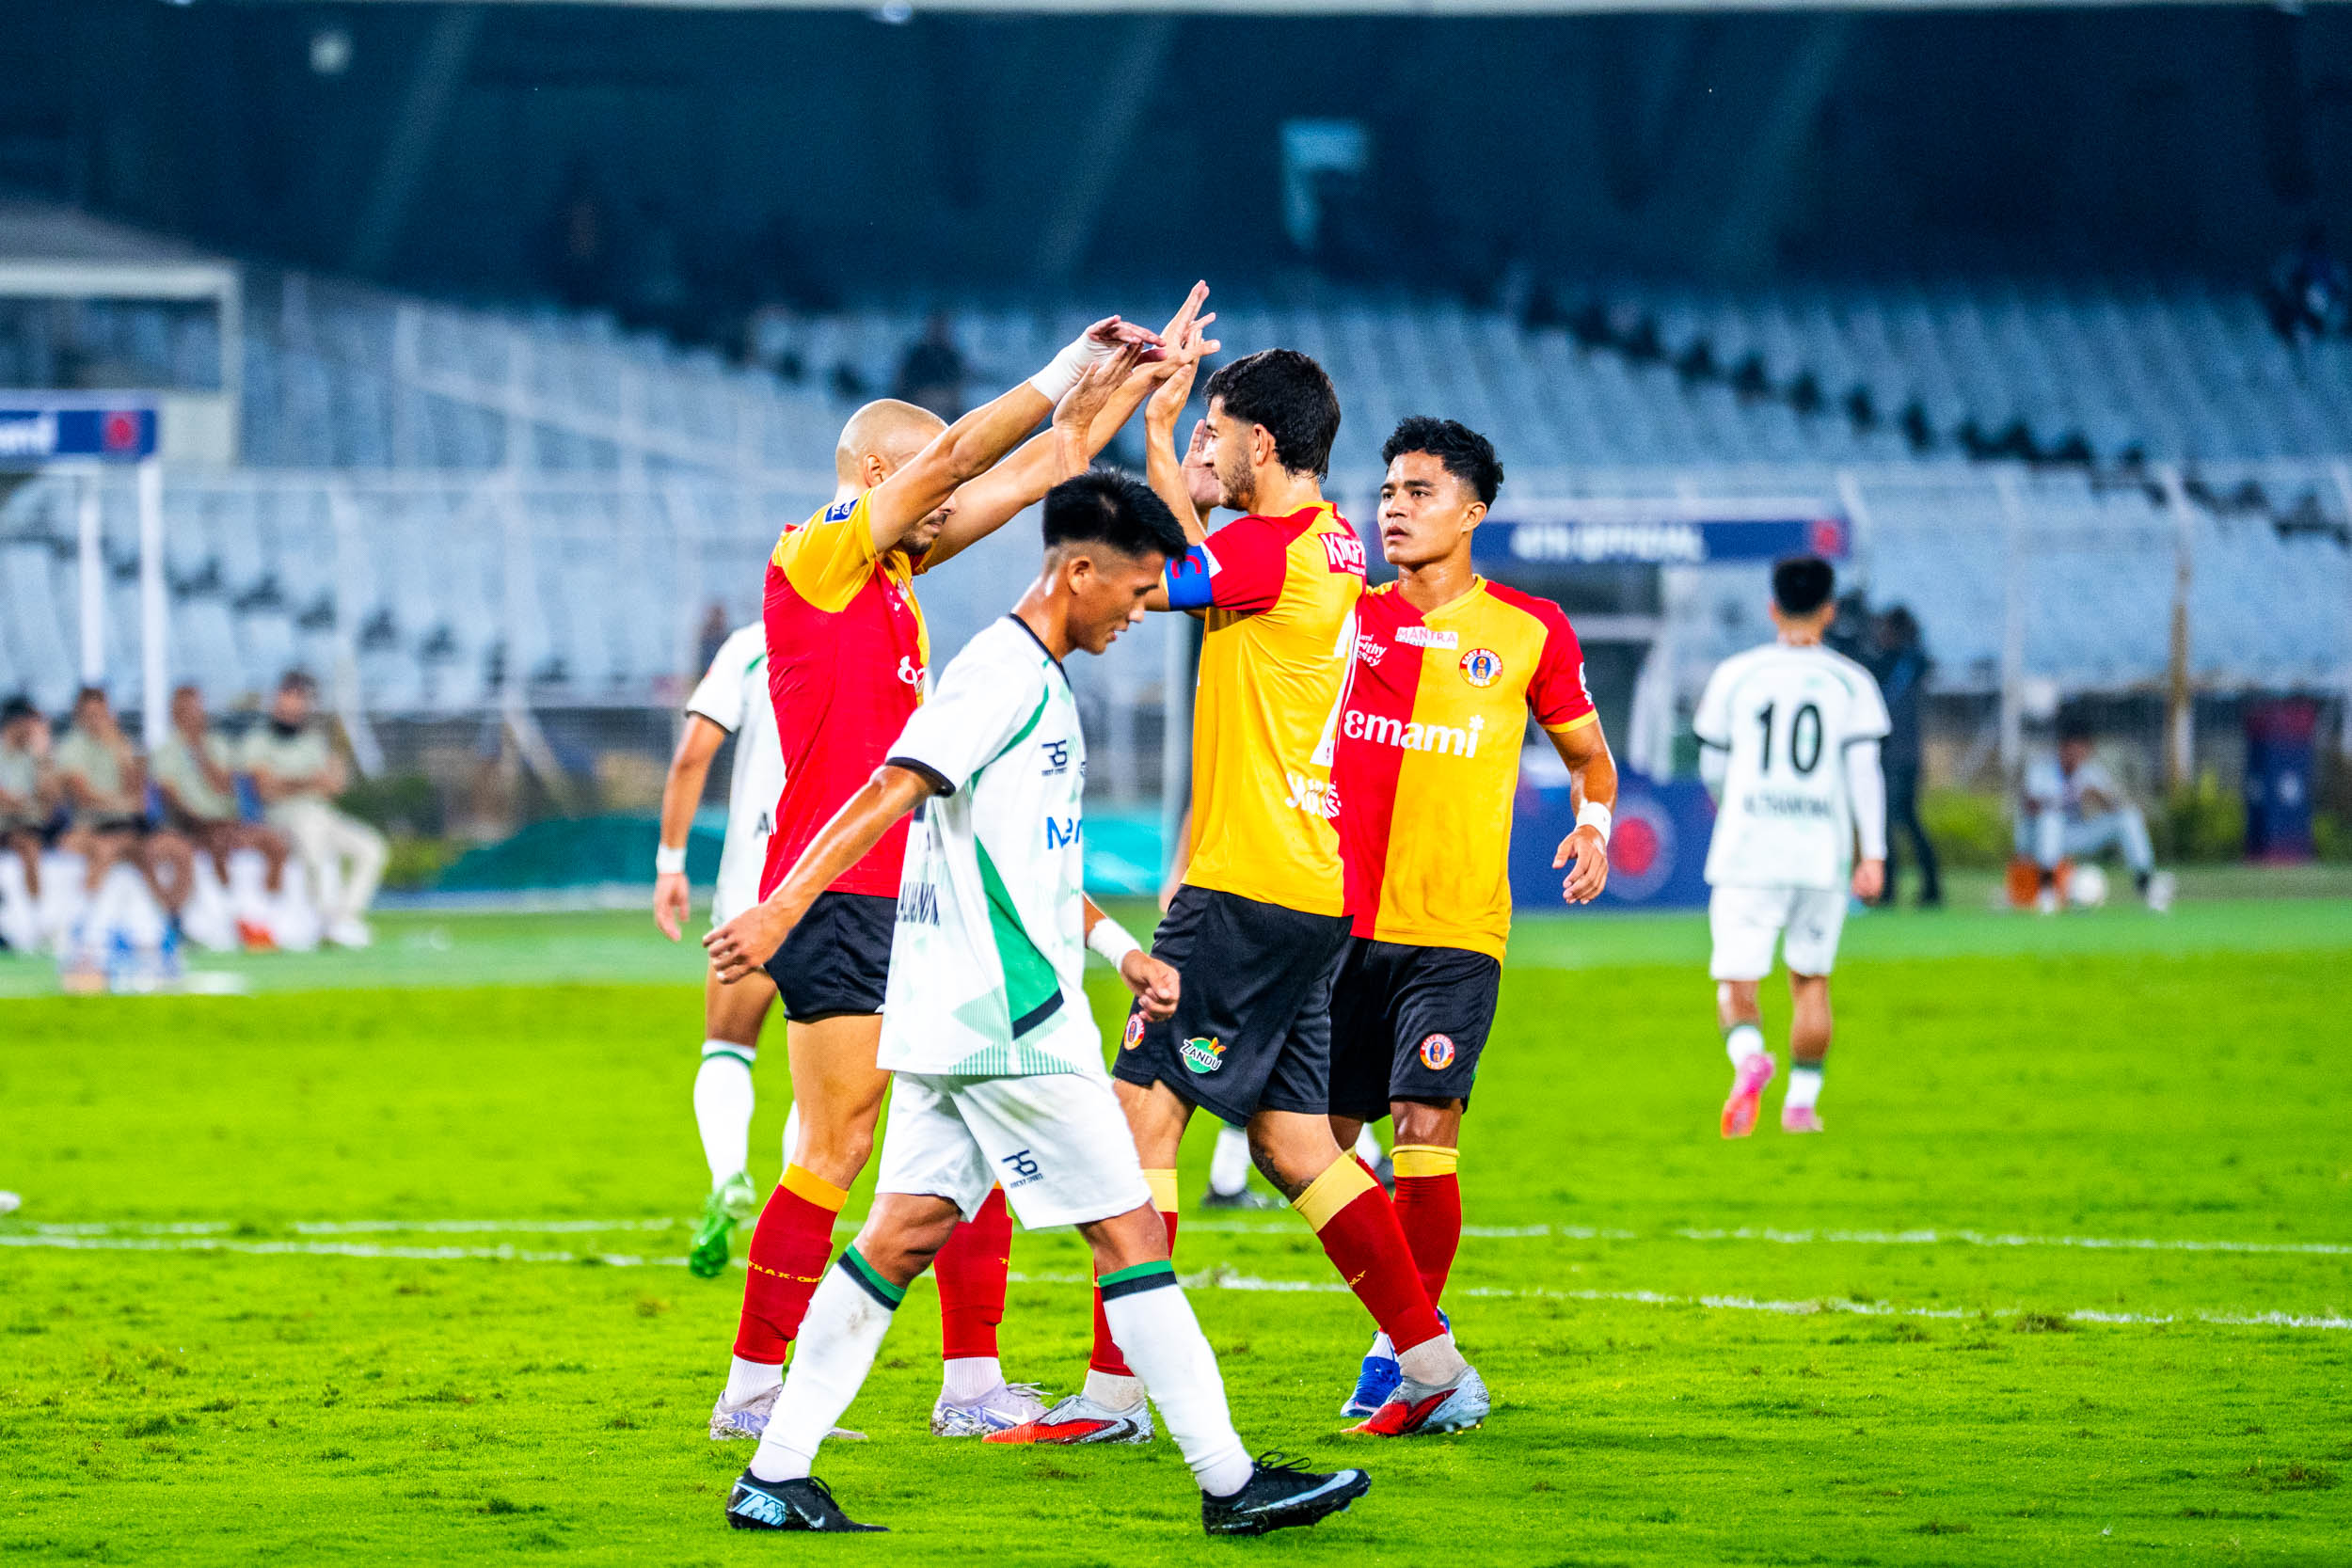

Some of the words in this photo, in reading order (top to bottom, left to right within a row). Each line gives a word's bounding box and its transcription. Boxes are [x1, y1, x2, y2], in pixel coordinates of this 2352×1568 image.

[1397, 628, 1456, 642] MANTRA
[1343, 709, 1485, 758] emami
[1756, 701, 1823, 775] 10
[1180, 1038, 1222, 1070] ZANDU
